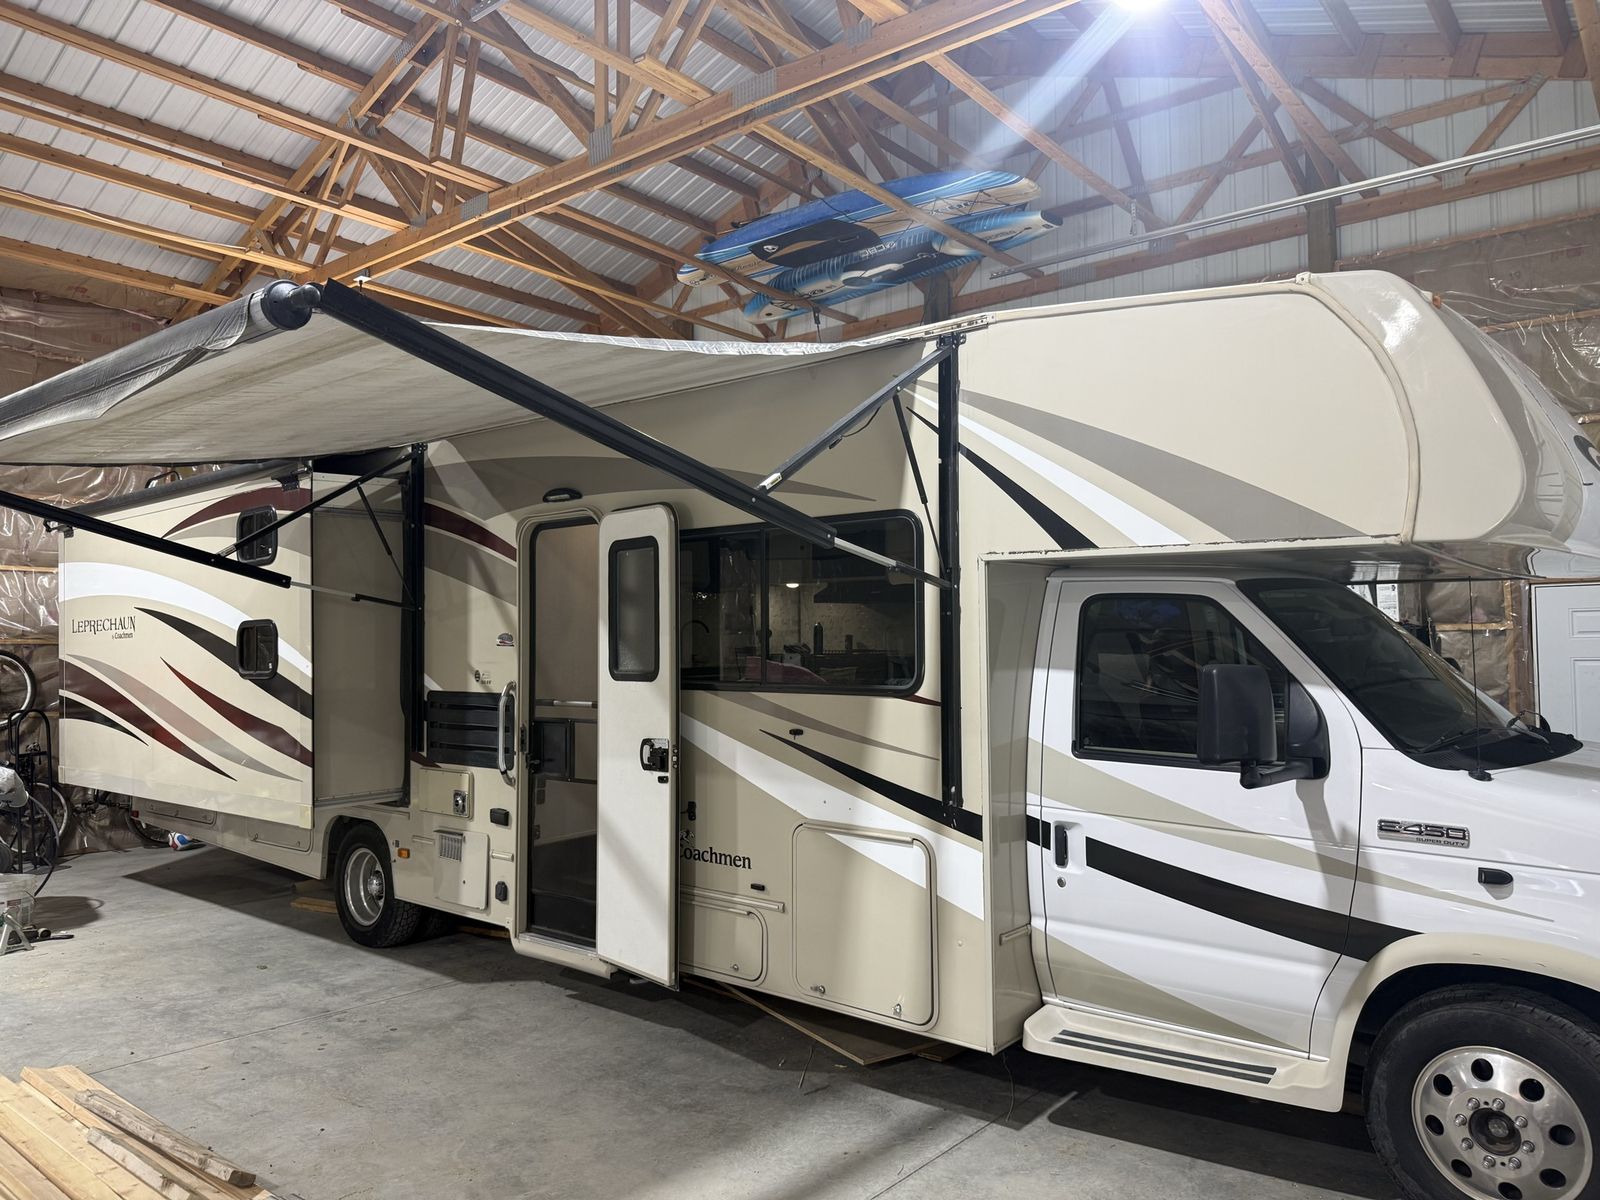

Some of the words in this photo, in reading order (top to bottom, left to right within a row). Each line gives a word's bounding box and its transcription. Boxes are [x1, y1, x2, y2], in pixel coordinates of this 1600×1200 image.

[72, 616, 136, 635] LEPRECHAUN
[115, 632, 133, 640] Coachmen
[680, 844, 752, 869] oachmen
